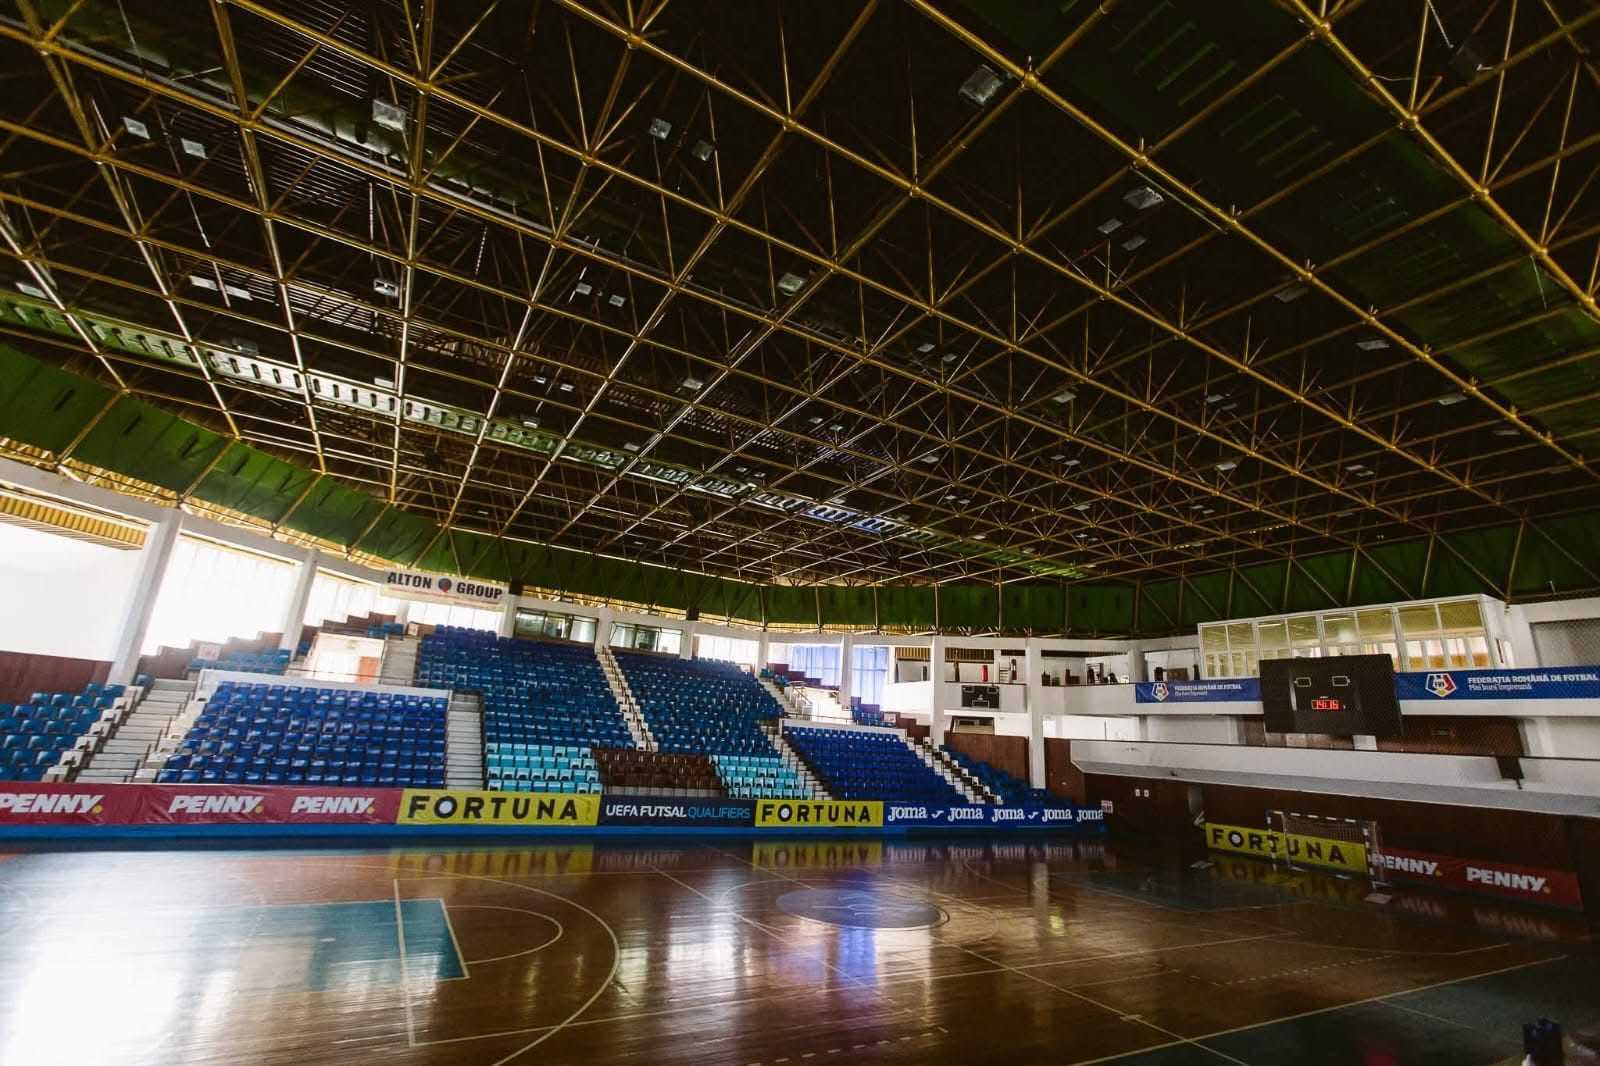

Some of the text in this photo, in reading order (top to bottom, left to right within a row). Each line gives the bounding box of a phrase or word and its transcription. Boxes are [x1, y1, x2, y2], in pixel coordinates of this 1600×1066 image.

[387, 571, 502, 599] ALTON GROUP
[407, 796, 578, 820] FORTUNA
[606, 804, 751, 819] UEFA FUTSAL QUALIFIERS
[761, 803, 871, 822] FORTUNA
[1212, 828, 1347, 865] FORTUNA
